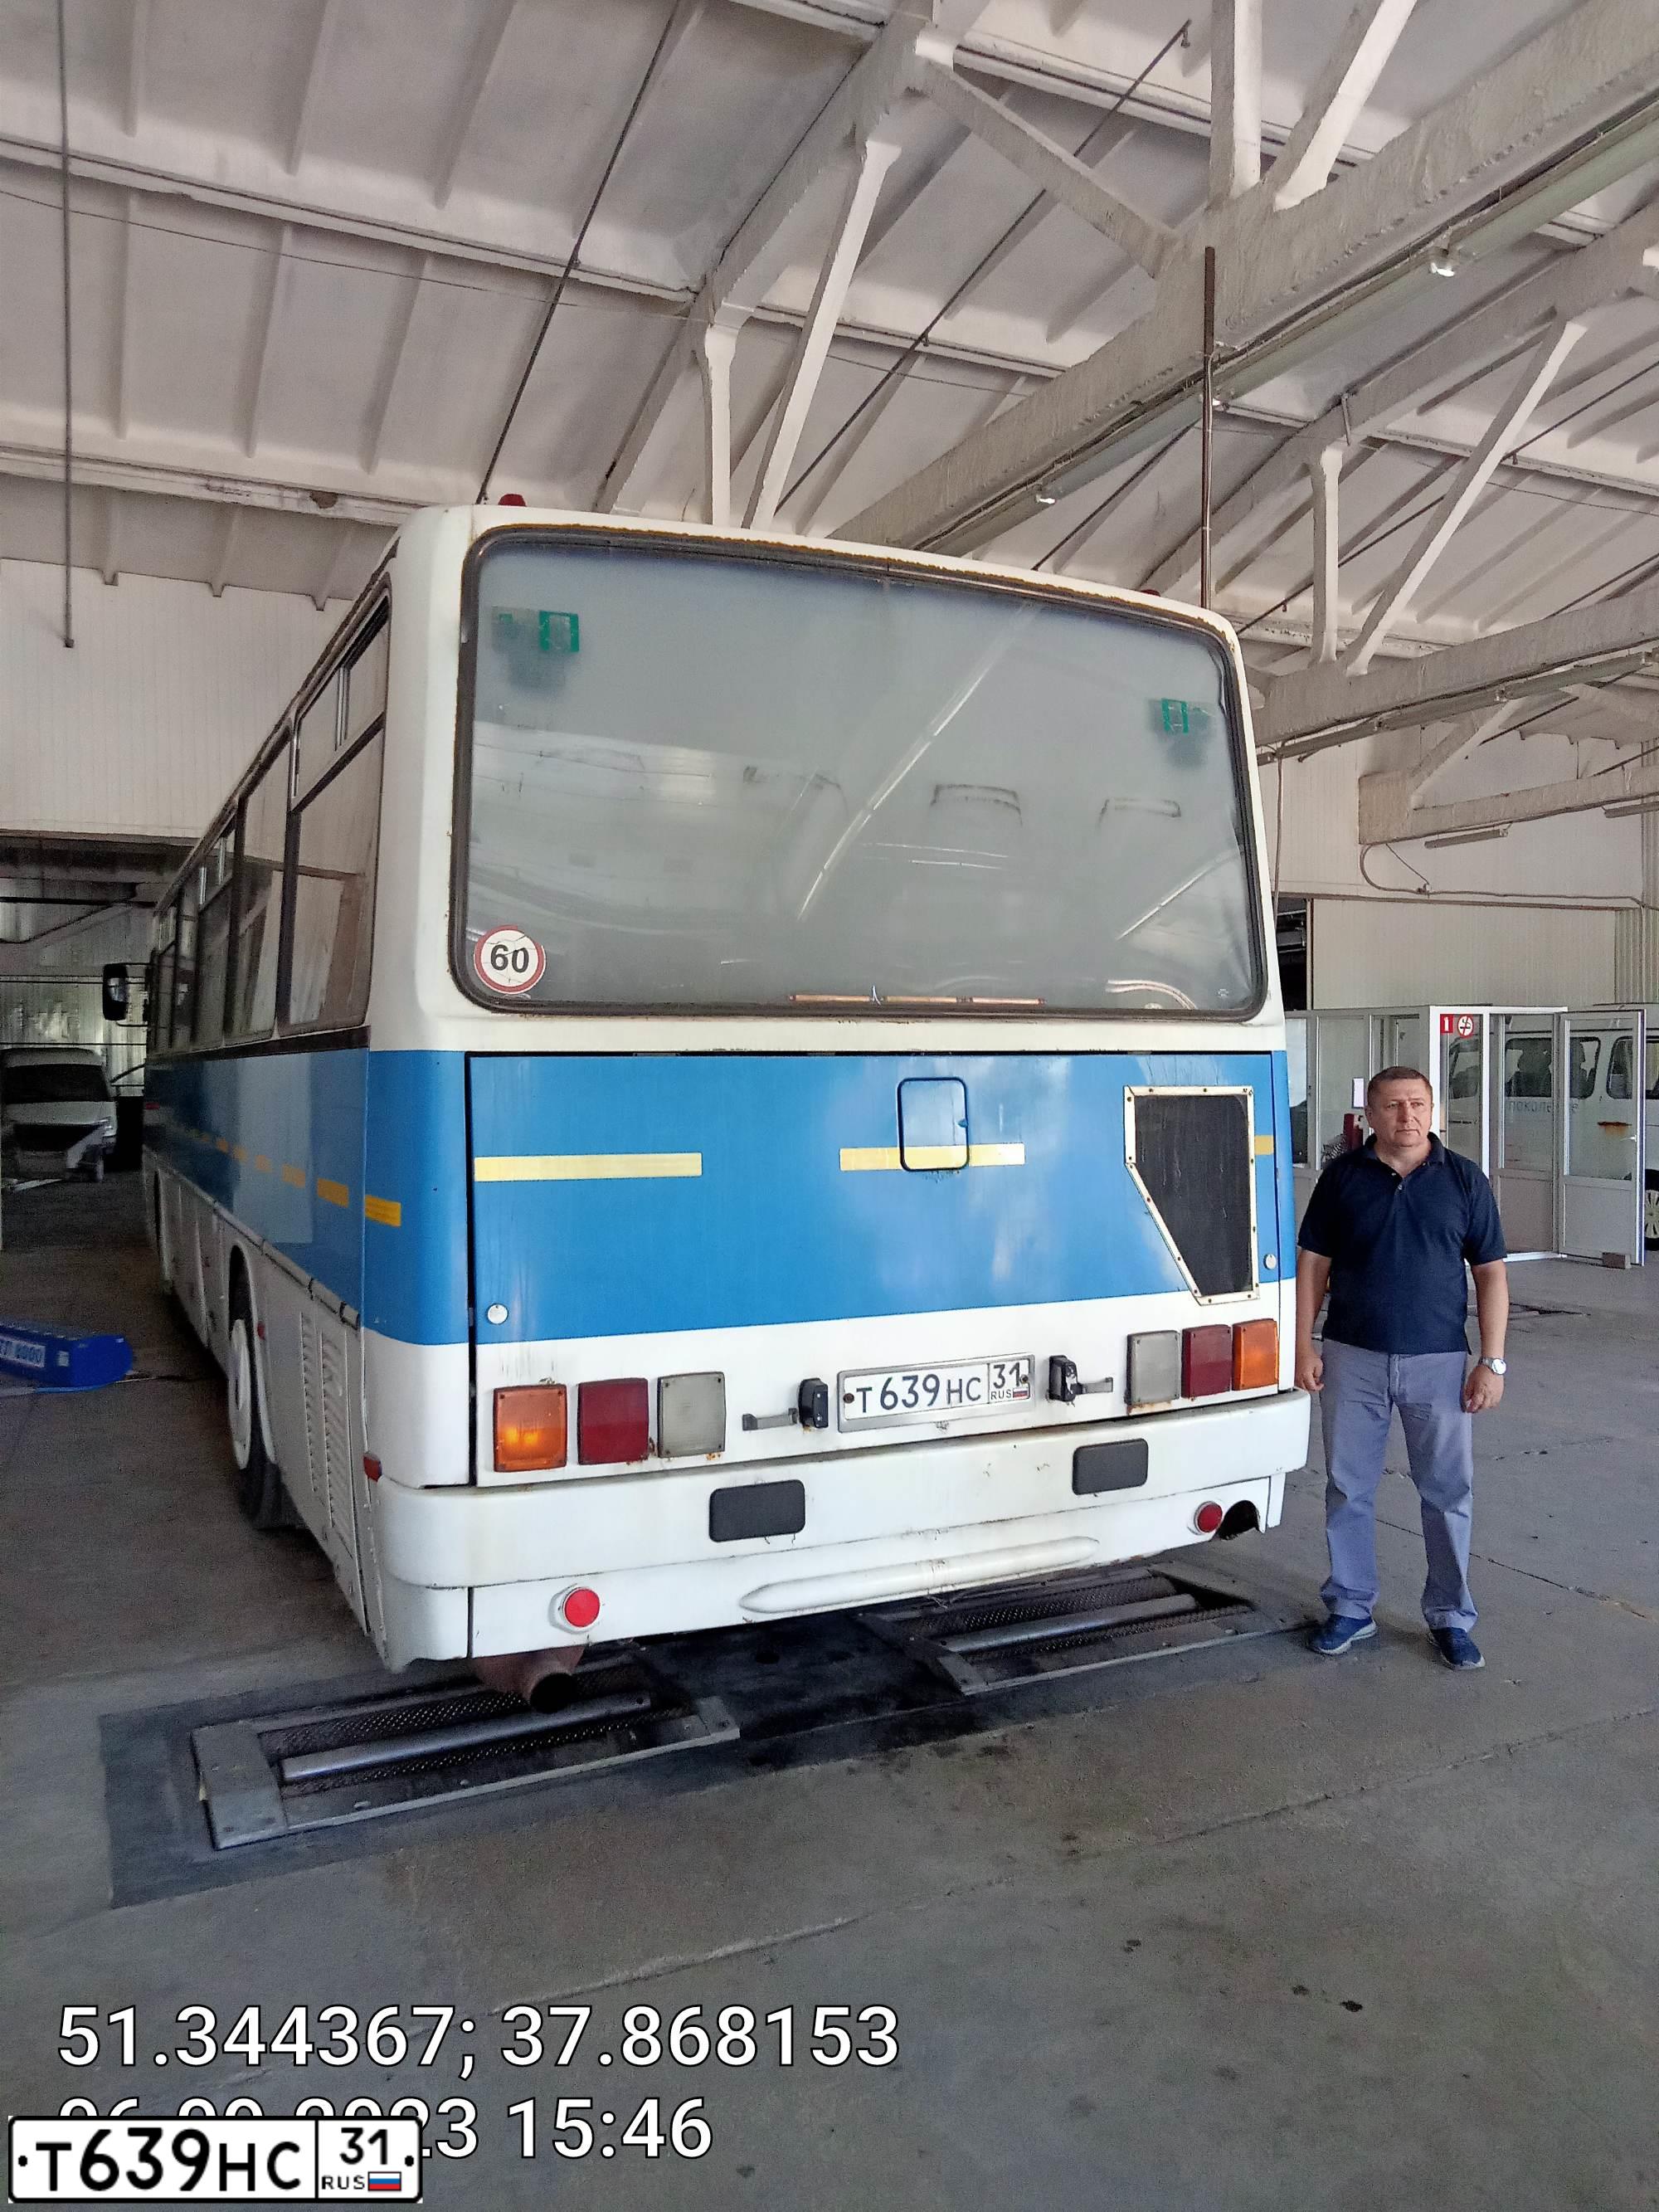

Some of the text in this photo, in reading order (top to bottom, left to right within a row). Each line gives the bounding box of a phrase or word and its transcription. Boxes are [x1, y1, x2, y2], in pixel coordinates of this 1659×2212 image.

[490, 944, 529, 973] 60
[1443, 1016, 1450, 1031] 1
[855, 1362, 1021, 1413] Т639НС 31
[990, 1388, 1012, 1401] RUS
